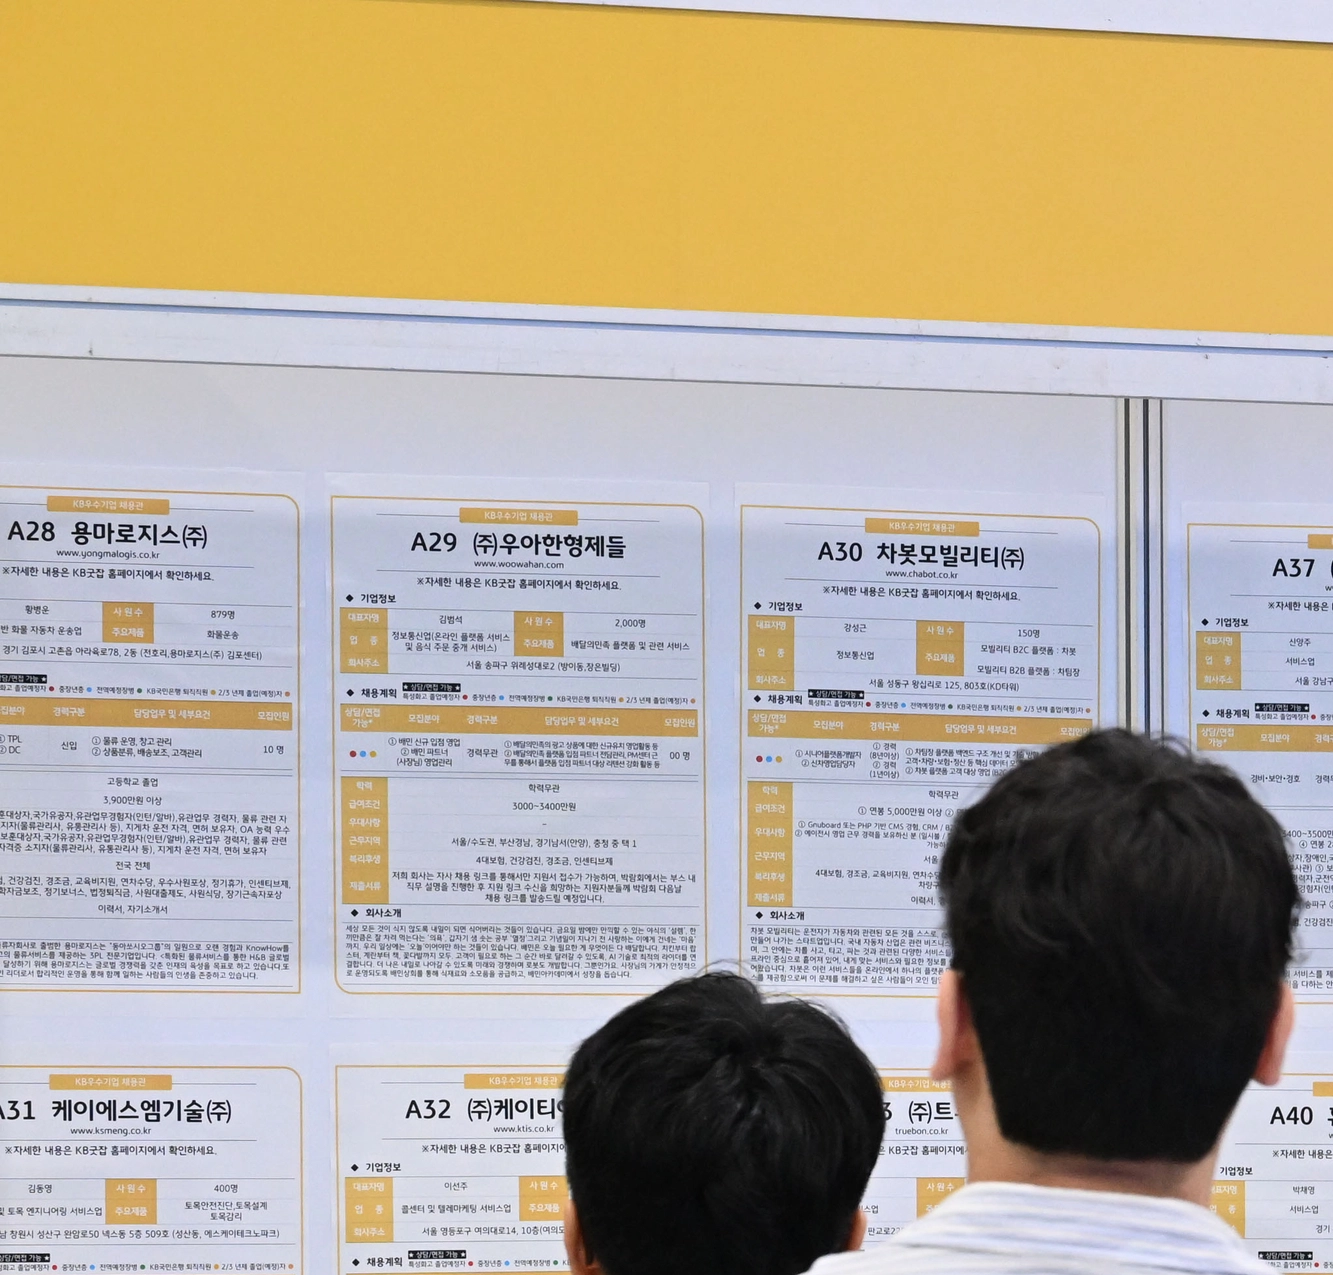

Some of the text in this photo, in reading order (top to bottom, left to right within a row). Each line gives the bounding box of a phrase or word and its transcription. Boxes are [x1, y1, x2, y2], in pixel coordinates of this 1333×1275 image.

[8, 521, 55, 541] A28
[411, 532, 456, 552] A29
[56, 549, 160, 561] www.yongmalogis.co.kr
[818, 542, 862, 561] A30
[473, 560, 565, 569] www.woowahan.com
[1273, 559, 1315, 577] A37
[41, 566, 70, 578] 내용은
[72, 568, 105, 579] KB굿잡
[107, 568, 163, 581] 홈페이지에서
[165, 570, 214, 582] 확인하세요.
[885, 569, 958, 579] www.chabot.co.kr
[360, 593, 397, 605] 기업정보
[210, 610, 236, 620] 879명
[614, 618, 646, 629] 2,000명
[1018, 629, 1040, 639] 150명
[361, 687, 397, 699] 채용계획
[365, 908, 402, 918] 회사소개
[406, 1100, 450, 1119] A32
[1270, 1107, 1313, 1125] A40
[70, 1126, 152, 1137] www.ksmeng.co.kr
[493, 1124, 555, 1133] www.ktis.co.kr
[894, 1126, 949, 1136] truebon.co.kr
[1308, 1149, 1333, 1160] 내용은
[213, 1183, 239, 1194] 400명
